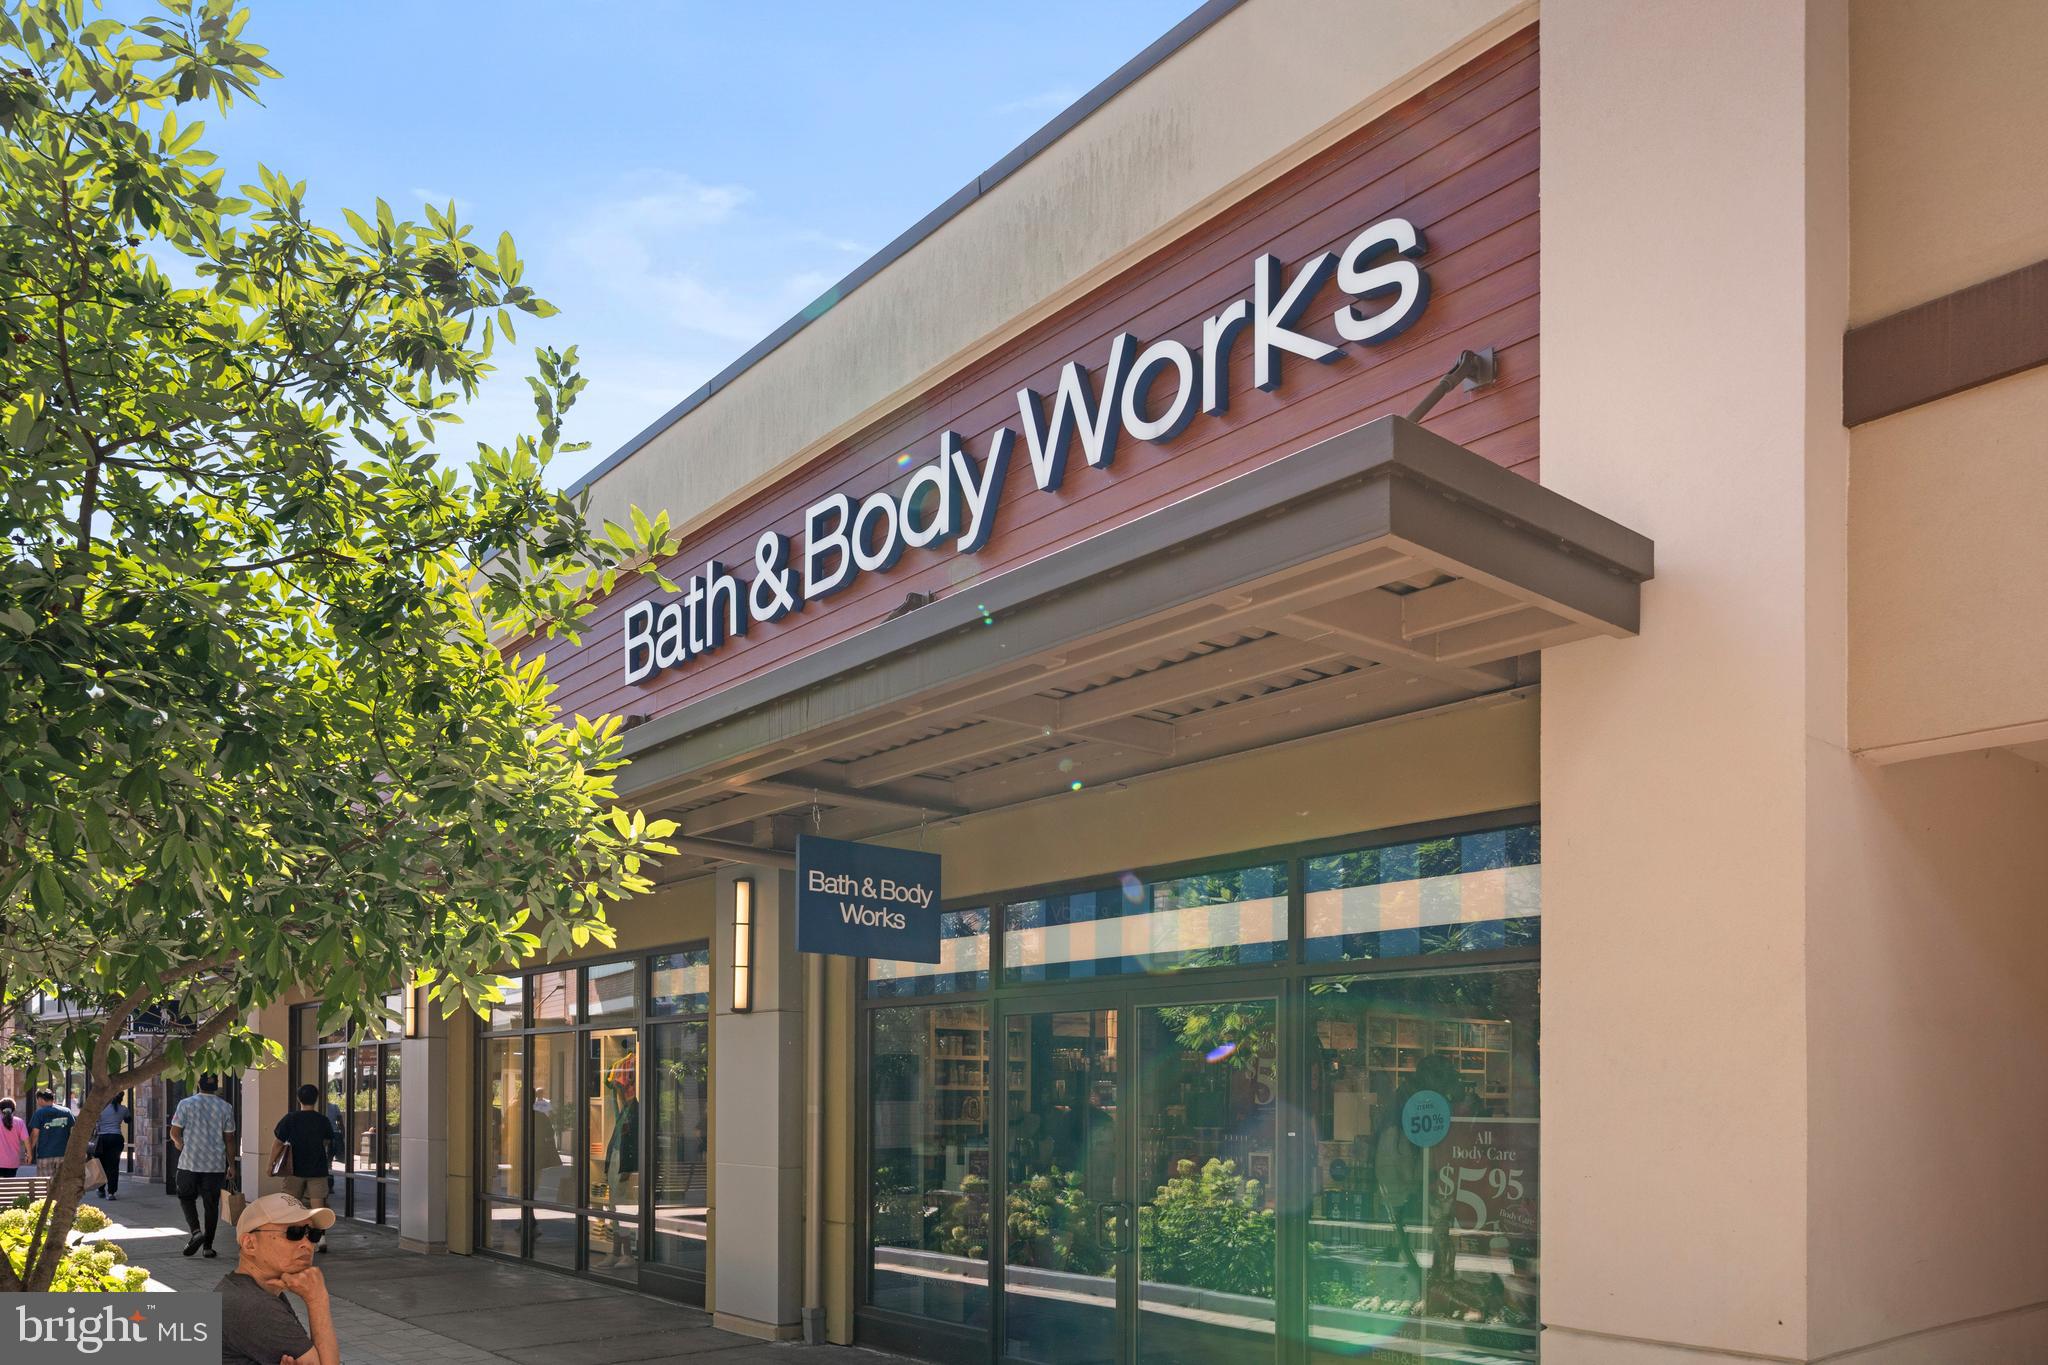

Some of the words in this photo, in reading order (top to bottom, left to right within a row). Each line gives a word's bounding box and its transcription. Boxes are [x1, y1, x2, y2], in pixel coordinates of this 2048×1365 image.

[624, 560, 742, 686] Bath
[749, 532, 799, 623] &
[804, 428, 1014, 600] Body
[1017, 218, 1428, 492] Works
[808, 869, 858, 897] Bath
[861, 877, 878, 899] &
[880, 879, 933, 909] Body
[839, 902, 906, 930] Works
[1475, 1131, 1492, 1145] All
[1452, 1146, 1484, 1164] Body
[1487, 1146, 1516, 1161] Care
